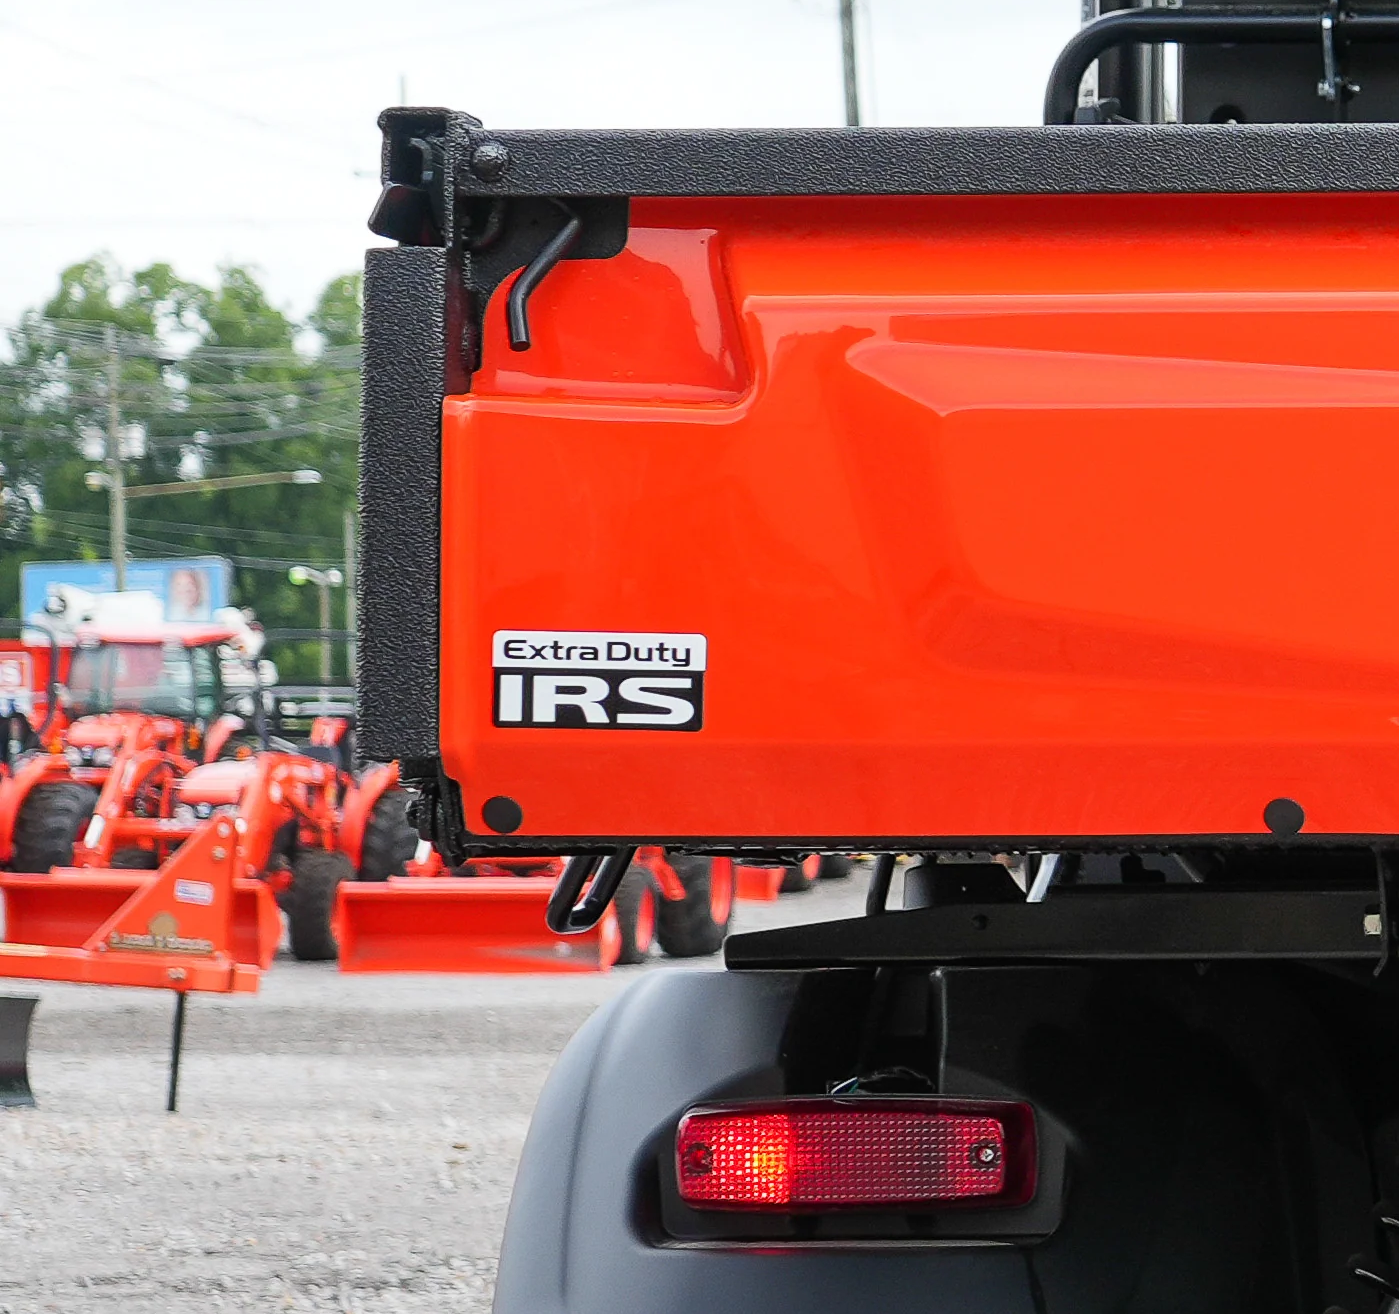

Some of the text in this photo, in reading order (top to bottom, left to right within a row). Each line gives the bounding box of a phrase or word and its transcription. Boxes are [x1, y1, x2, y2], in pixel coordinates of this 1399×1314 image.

[503, 639, 691, 667] Extra Duty
[499, 674, 695, 724] IRS
